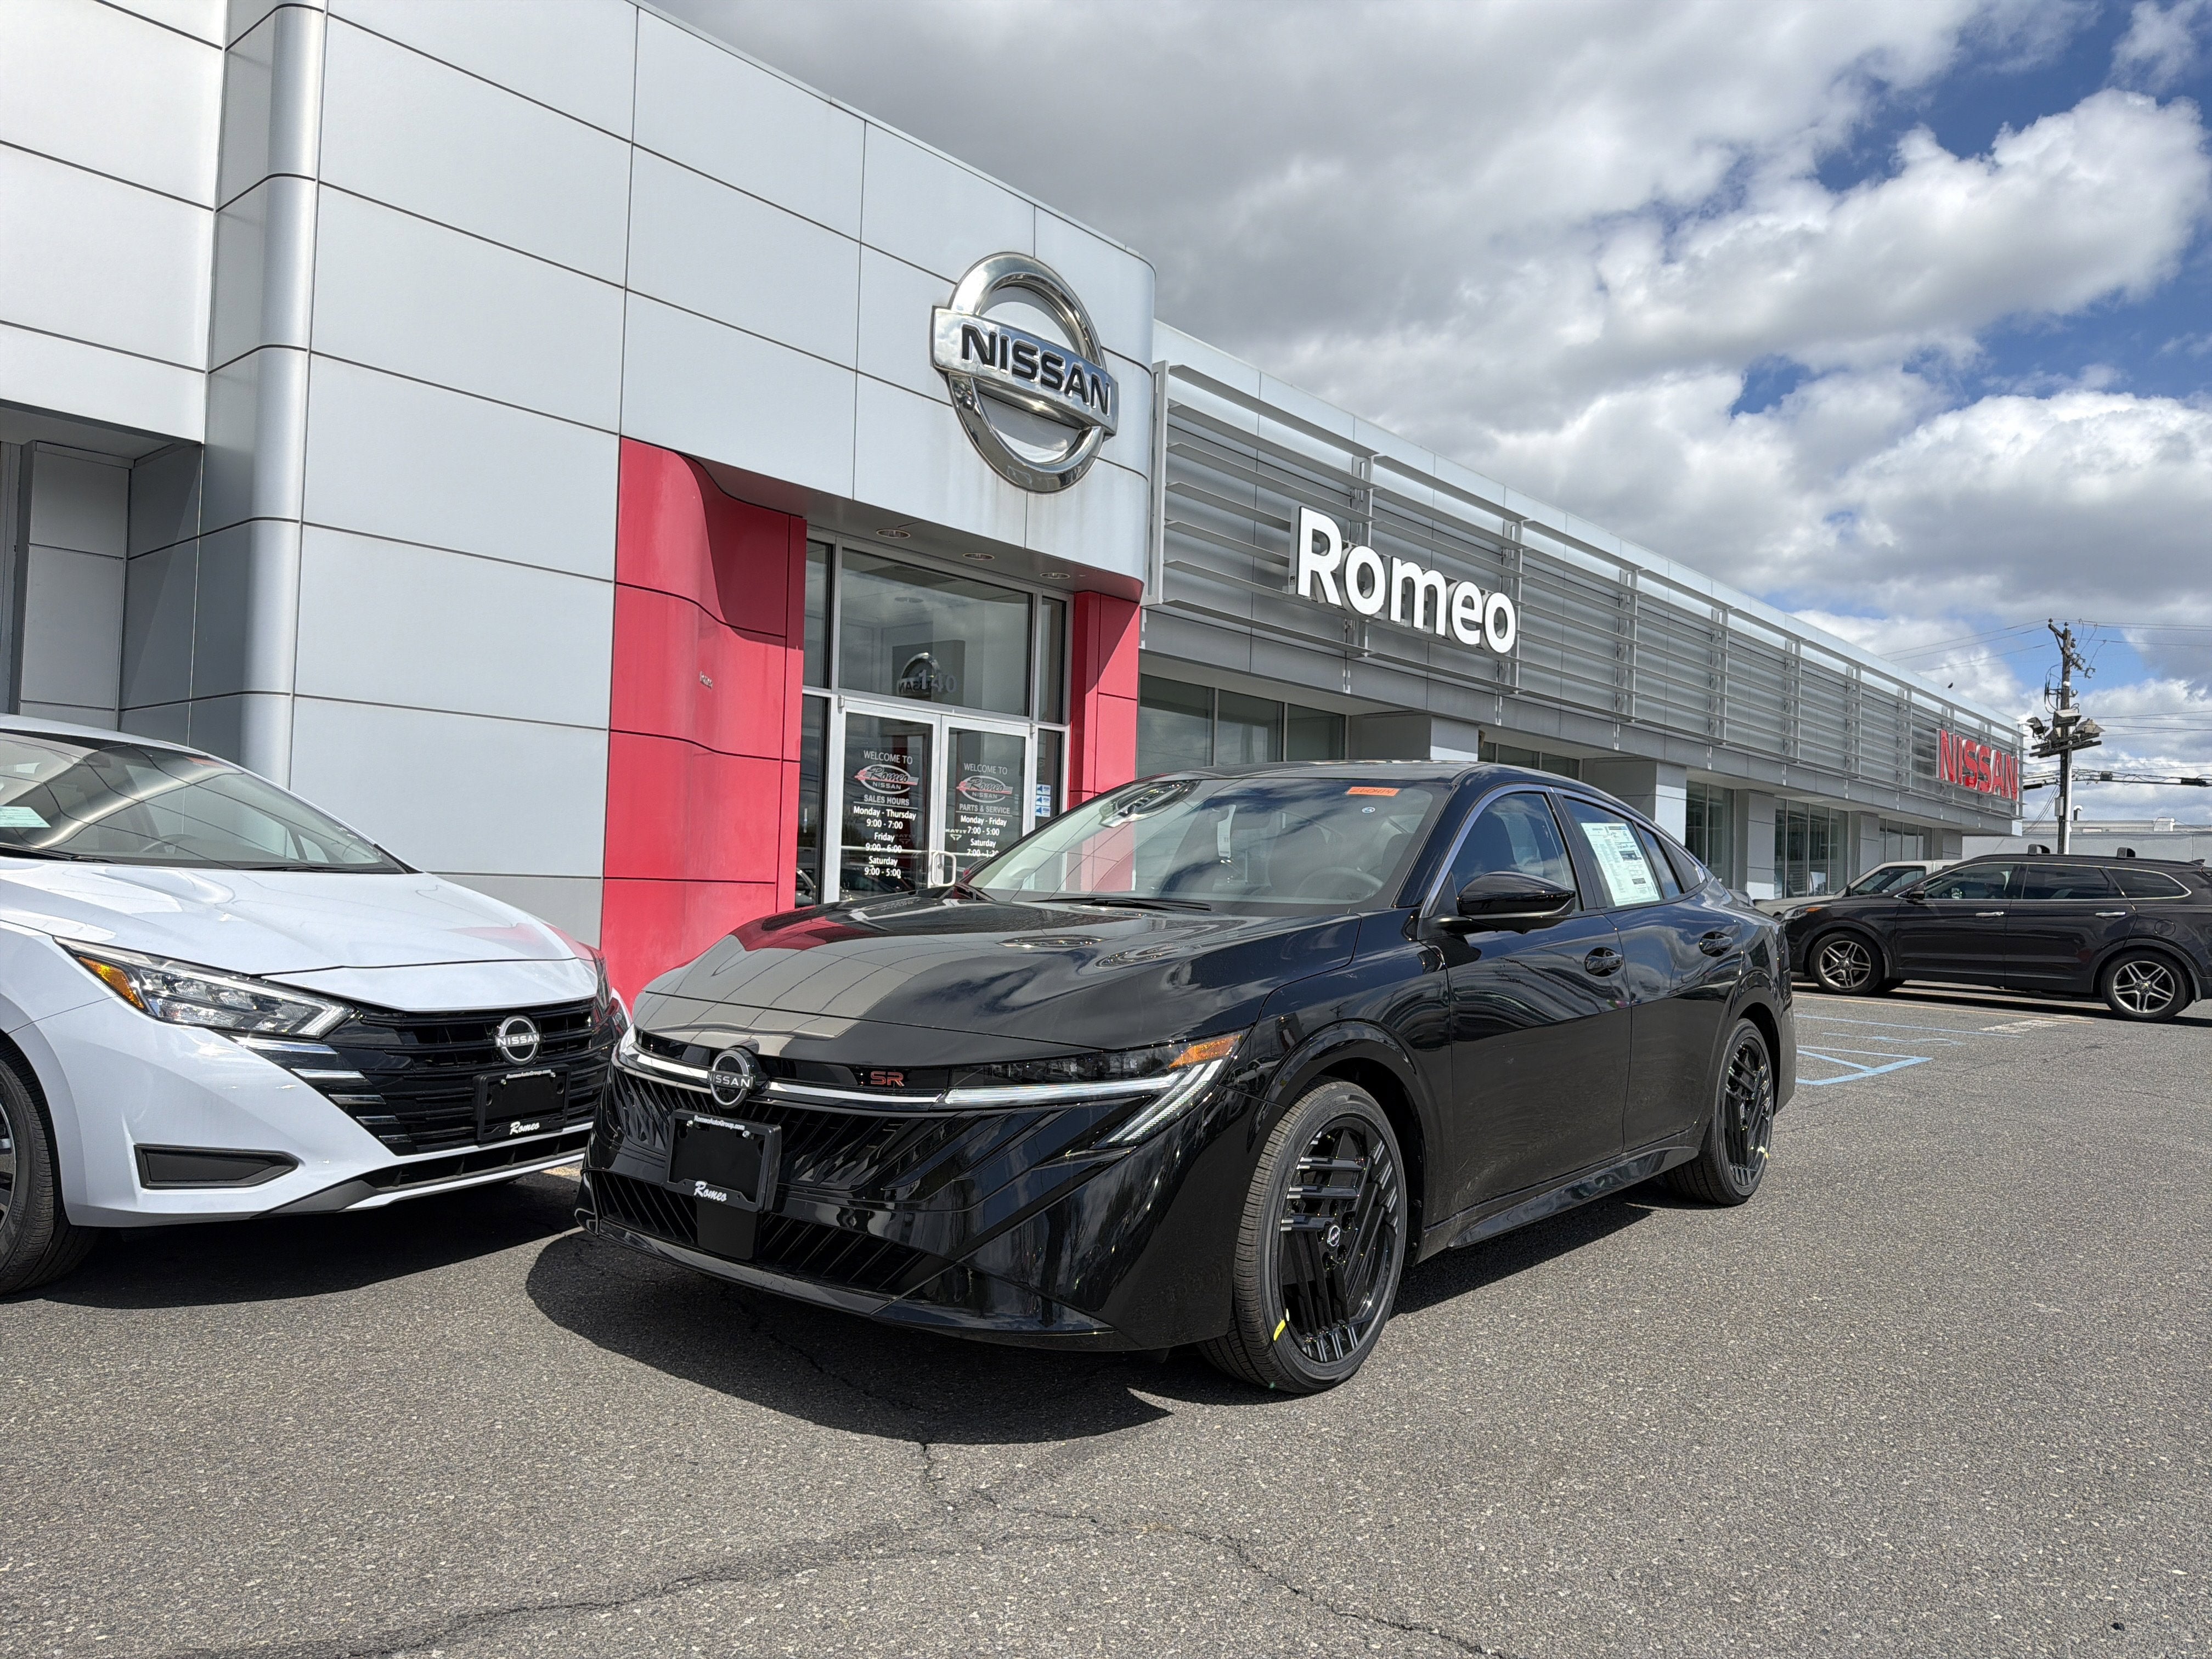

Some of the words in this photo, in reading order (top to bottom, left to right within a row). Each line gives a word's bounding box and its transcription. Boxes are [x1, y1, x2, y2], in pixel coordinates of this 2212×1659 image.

[961, 324, 1110, 417] NISSAN
[1295, 505, 1516, 654] Romeo
[919, 669, 957, 693] 140
[864, 750, 900, 764] WELCOME
[902, 755, 913, 765] TO
[964, 763, 996, 774] WELCOME
[998, 766, 1008, 775] TO
[1940, 729, 2018, 801] NISSAN
[867, 765, 909, 783] Romeo
[872, 782, 901, 790] NISSAN
[968, 777, 1004, 792] Romeo
[864, 794, 885, 804] SALES
[887, 796, 910, 806] HOURS
[854, 806, 881, 817] Monday
[886, 809, 917, 821] Thursday
[959, 803, 978, 812] PARTS
[985, 805, 1011, 814] SERVICE
[866, 819, 882, 828] 9:00
[888, 820, 904, 830] 7:00
[961, 815, 984, 825] Monday
[989, 817, 1007, 827] Friday
[967, 826, 981, 834] 7:00
[986, 827, 1000, 836] 5:00
[874, 832, 895, 843] Friday
[970, 838, 996, 848] Saturday
[865, 842, 881, 851] 9:00
[887, 844, 902, 853] 6:00
[967, 848, 980, 857] 7:00
[868, 856, 898, 866] Saturday
[864, 867, 880, 876] 9:00
[886, 868, 901, 877] 5:00
[496, 1034, 540, 1046] NISSAN
[707, 1072, 751, 1087] NISSAN
[870, 1071, 905, 1087] SR
[509, 1121, 540, 1136] Romeo
[694, 1115, 745, 1130] RomeoAutoGroup.com
[693, 1181, 727, 1202] Romeo
